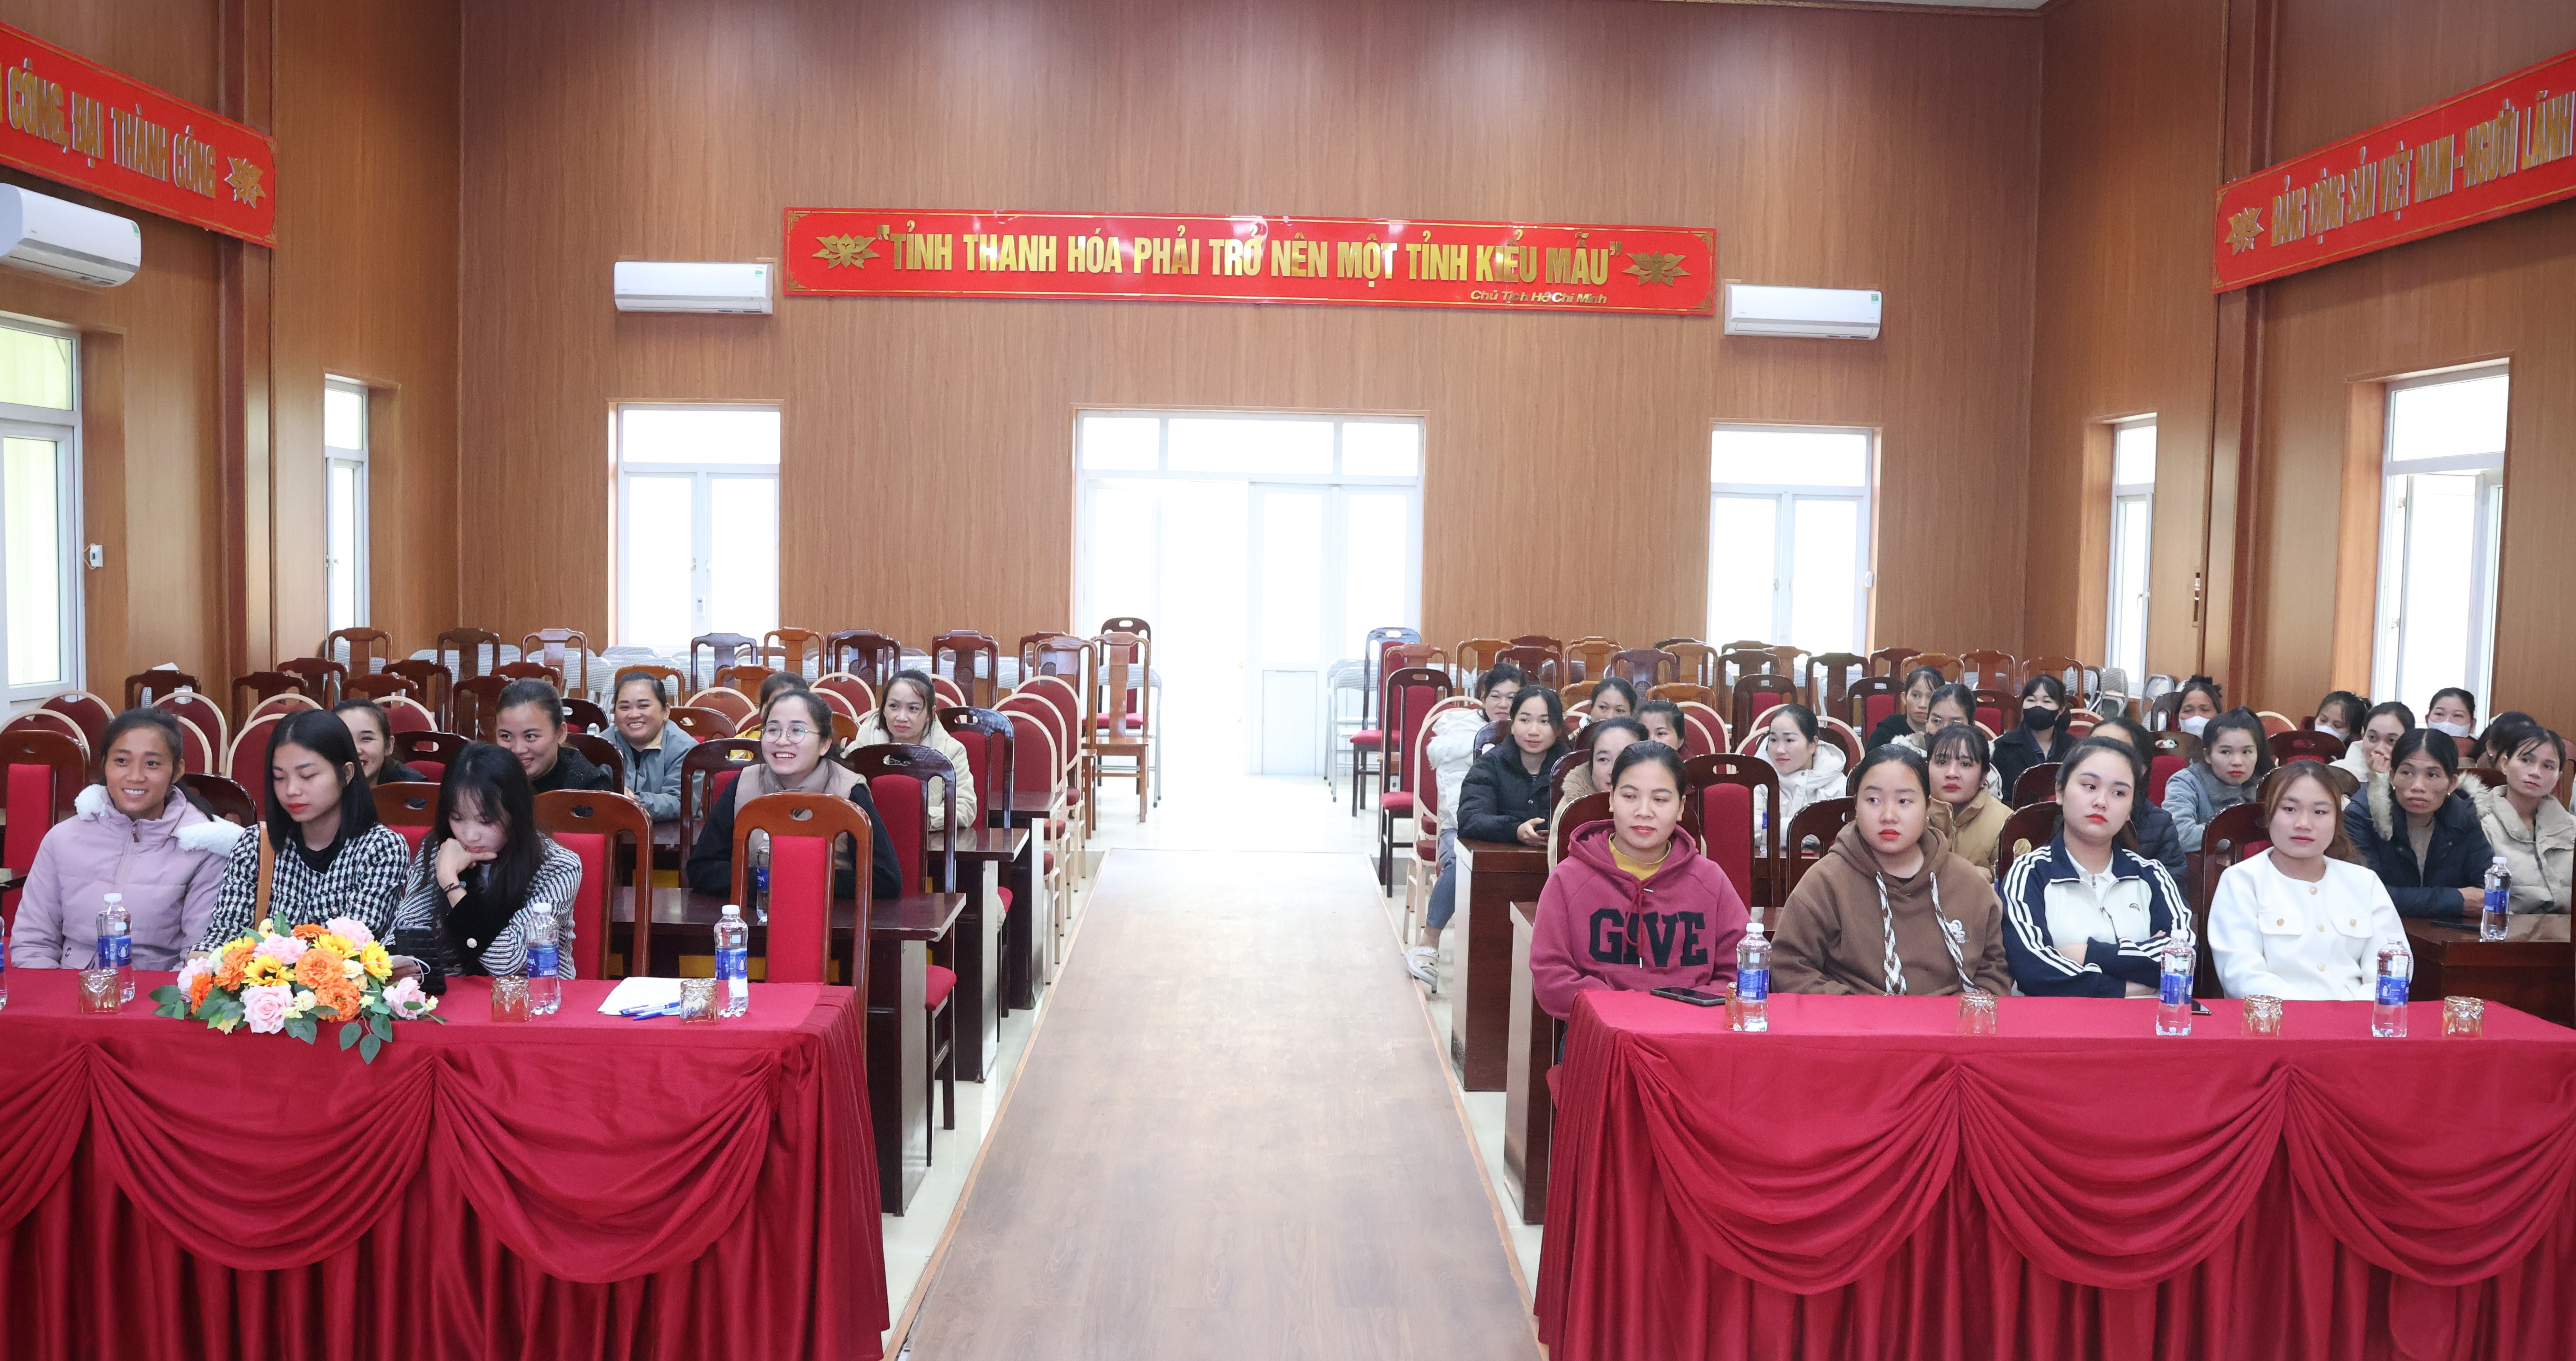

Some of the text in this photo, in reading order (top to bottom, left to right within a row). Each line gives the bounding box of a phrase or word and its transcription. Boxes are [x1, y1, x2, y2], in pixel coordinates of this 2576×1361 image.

[71, 91, 104, 168] ĐẠI
[111, 104, 169, 182] THÀNH
[173, 125, 216, 198] CÔNG
[2271, 175, 2306, 247] ĐẢNG
[2308, 168, 2345, 244] CỘNG
[2346, 146, 2377, 223] SẢN
[2380, 140, 2413, 221] VIỆT
[2521, 90, 2576, 170] LÃNH
[963, 234, 1057, 272] THANH
[1067, 228, 1123, 273] HÓA
[1134, 225, 1200, 275] PHẢI
[1209, 225, 1263, 276] TRỞ
[1271, 232, 1328, 277] NÊN
[1337, 233, 1397, 288] MỘT
[1406, 230, 1468, 280] TỈNH
[1476, 229, 1537, 283] KIỂU
[1470, 289, 1499, 301] Chủ
[1501, 291, 1529, 303] Tịch
[1577, 293, 1607, 304] Minh
[1589, 908, 1708, 967] GIVE
